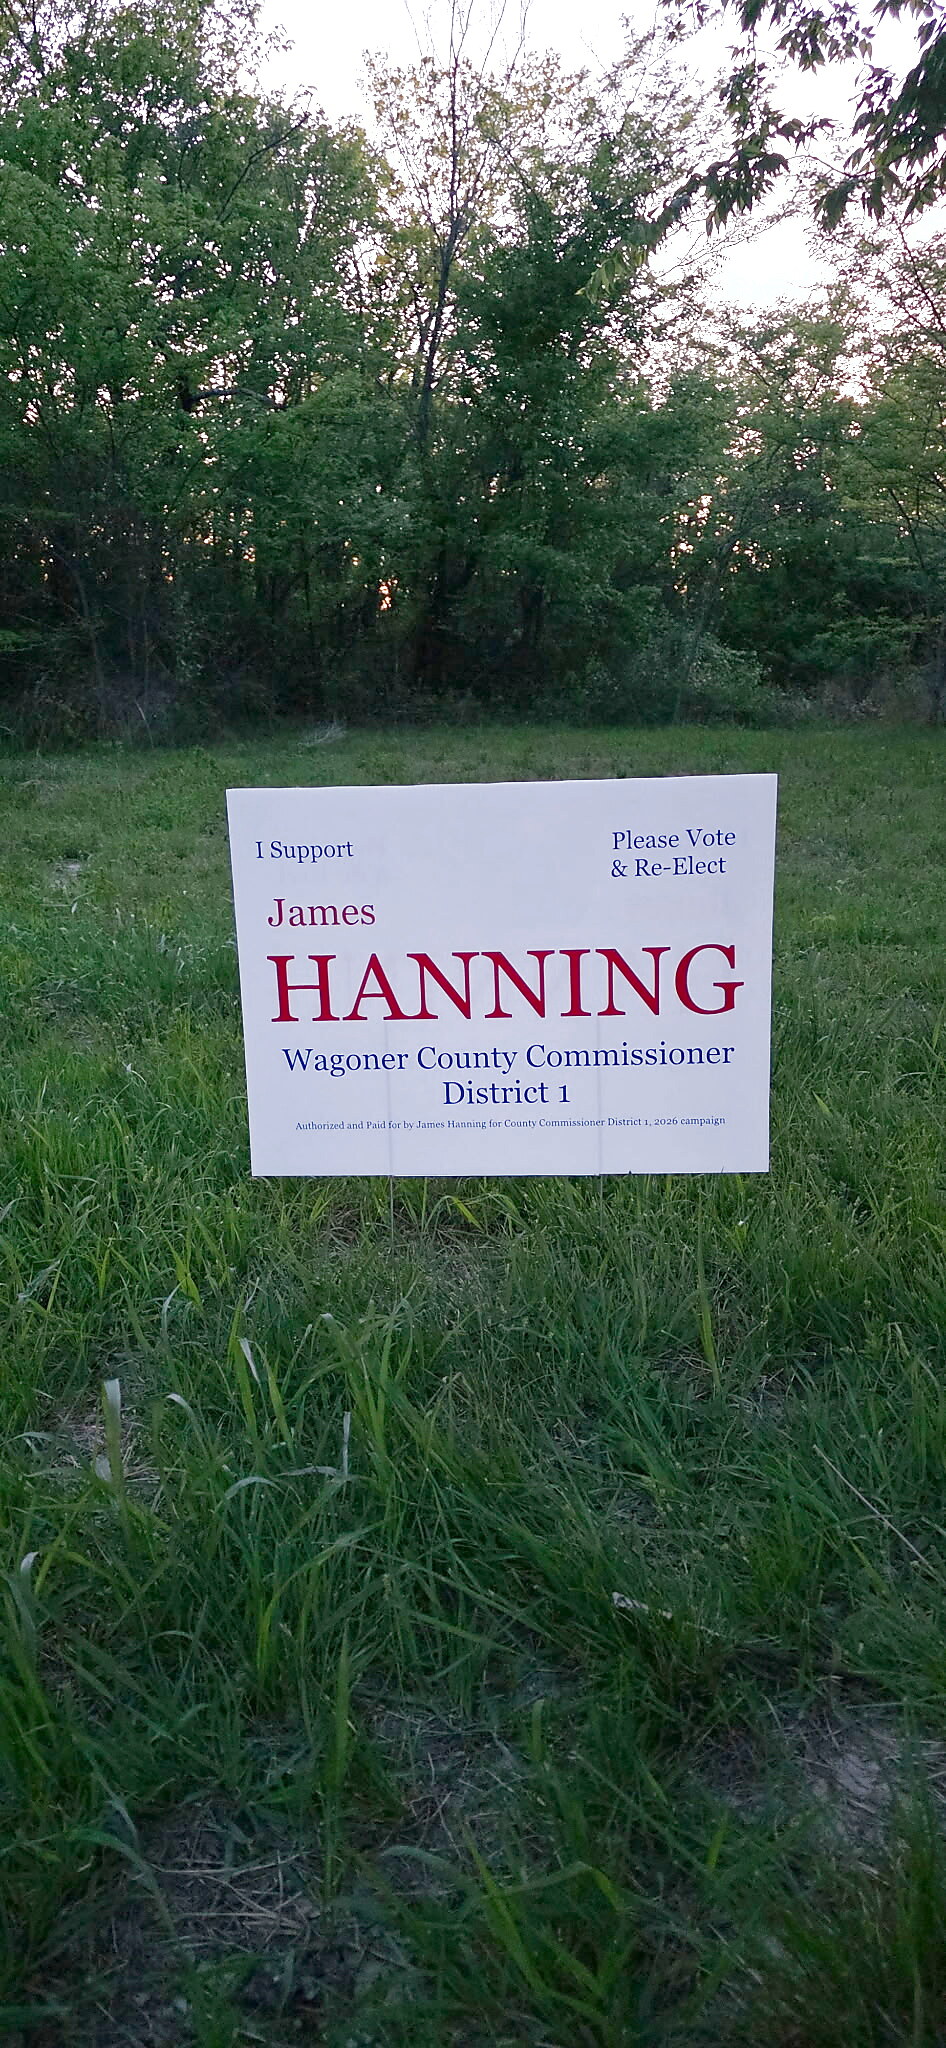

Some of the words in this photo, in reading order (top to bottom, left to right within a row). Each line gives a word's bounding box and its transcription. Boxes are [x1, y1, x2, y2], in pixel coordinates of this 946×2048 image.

[612, 829, 681, 851] Please
[684, 828, 737, 848] Vote
[255, 840, 265, 859] I
[270, 840, 354, 864] Support
[610, 859, 629, 878] &
[634, 855, 727, 877] Re-Elect
[267, 898, 376, 928] James
[266, 943, 745, 1023] HANNING
[282, 1047, 409, 1078] Wagoner
[416, 1045, 518, 1074] County
[525, 1040, 736, 1069] Commissioner
[442, 1080, 550, 1105] District
[558, 1084, 571, 1103] 1
[295, 1120, 345, 1131] Authorized
[346, 1120, 364, 1130] and
[366, 1120, 386, 1130] Paid
[388, 1120, 401, 1130] for
[402, 1120, 414, 1132] by
[416, 1120, 445, 1130] James
[447, 1119, 487, 1130] Hanning
[488, 1119, 503, 1129] for
[504, 1119, 537, 1129] County
[538, 1117, 606, 1128] Commissioner
[607, 1117, 642, 1127] District
[643, 1118, 652, 1127] 1,
[653, 1117, 679, 1127] 2026
[680, 1116, 726, 1128] campaign
